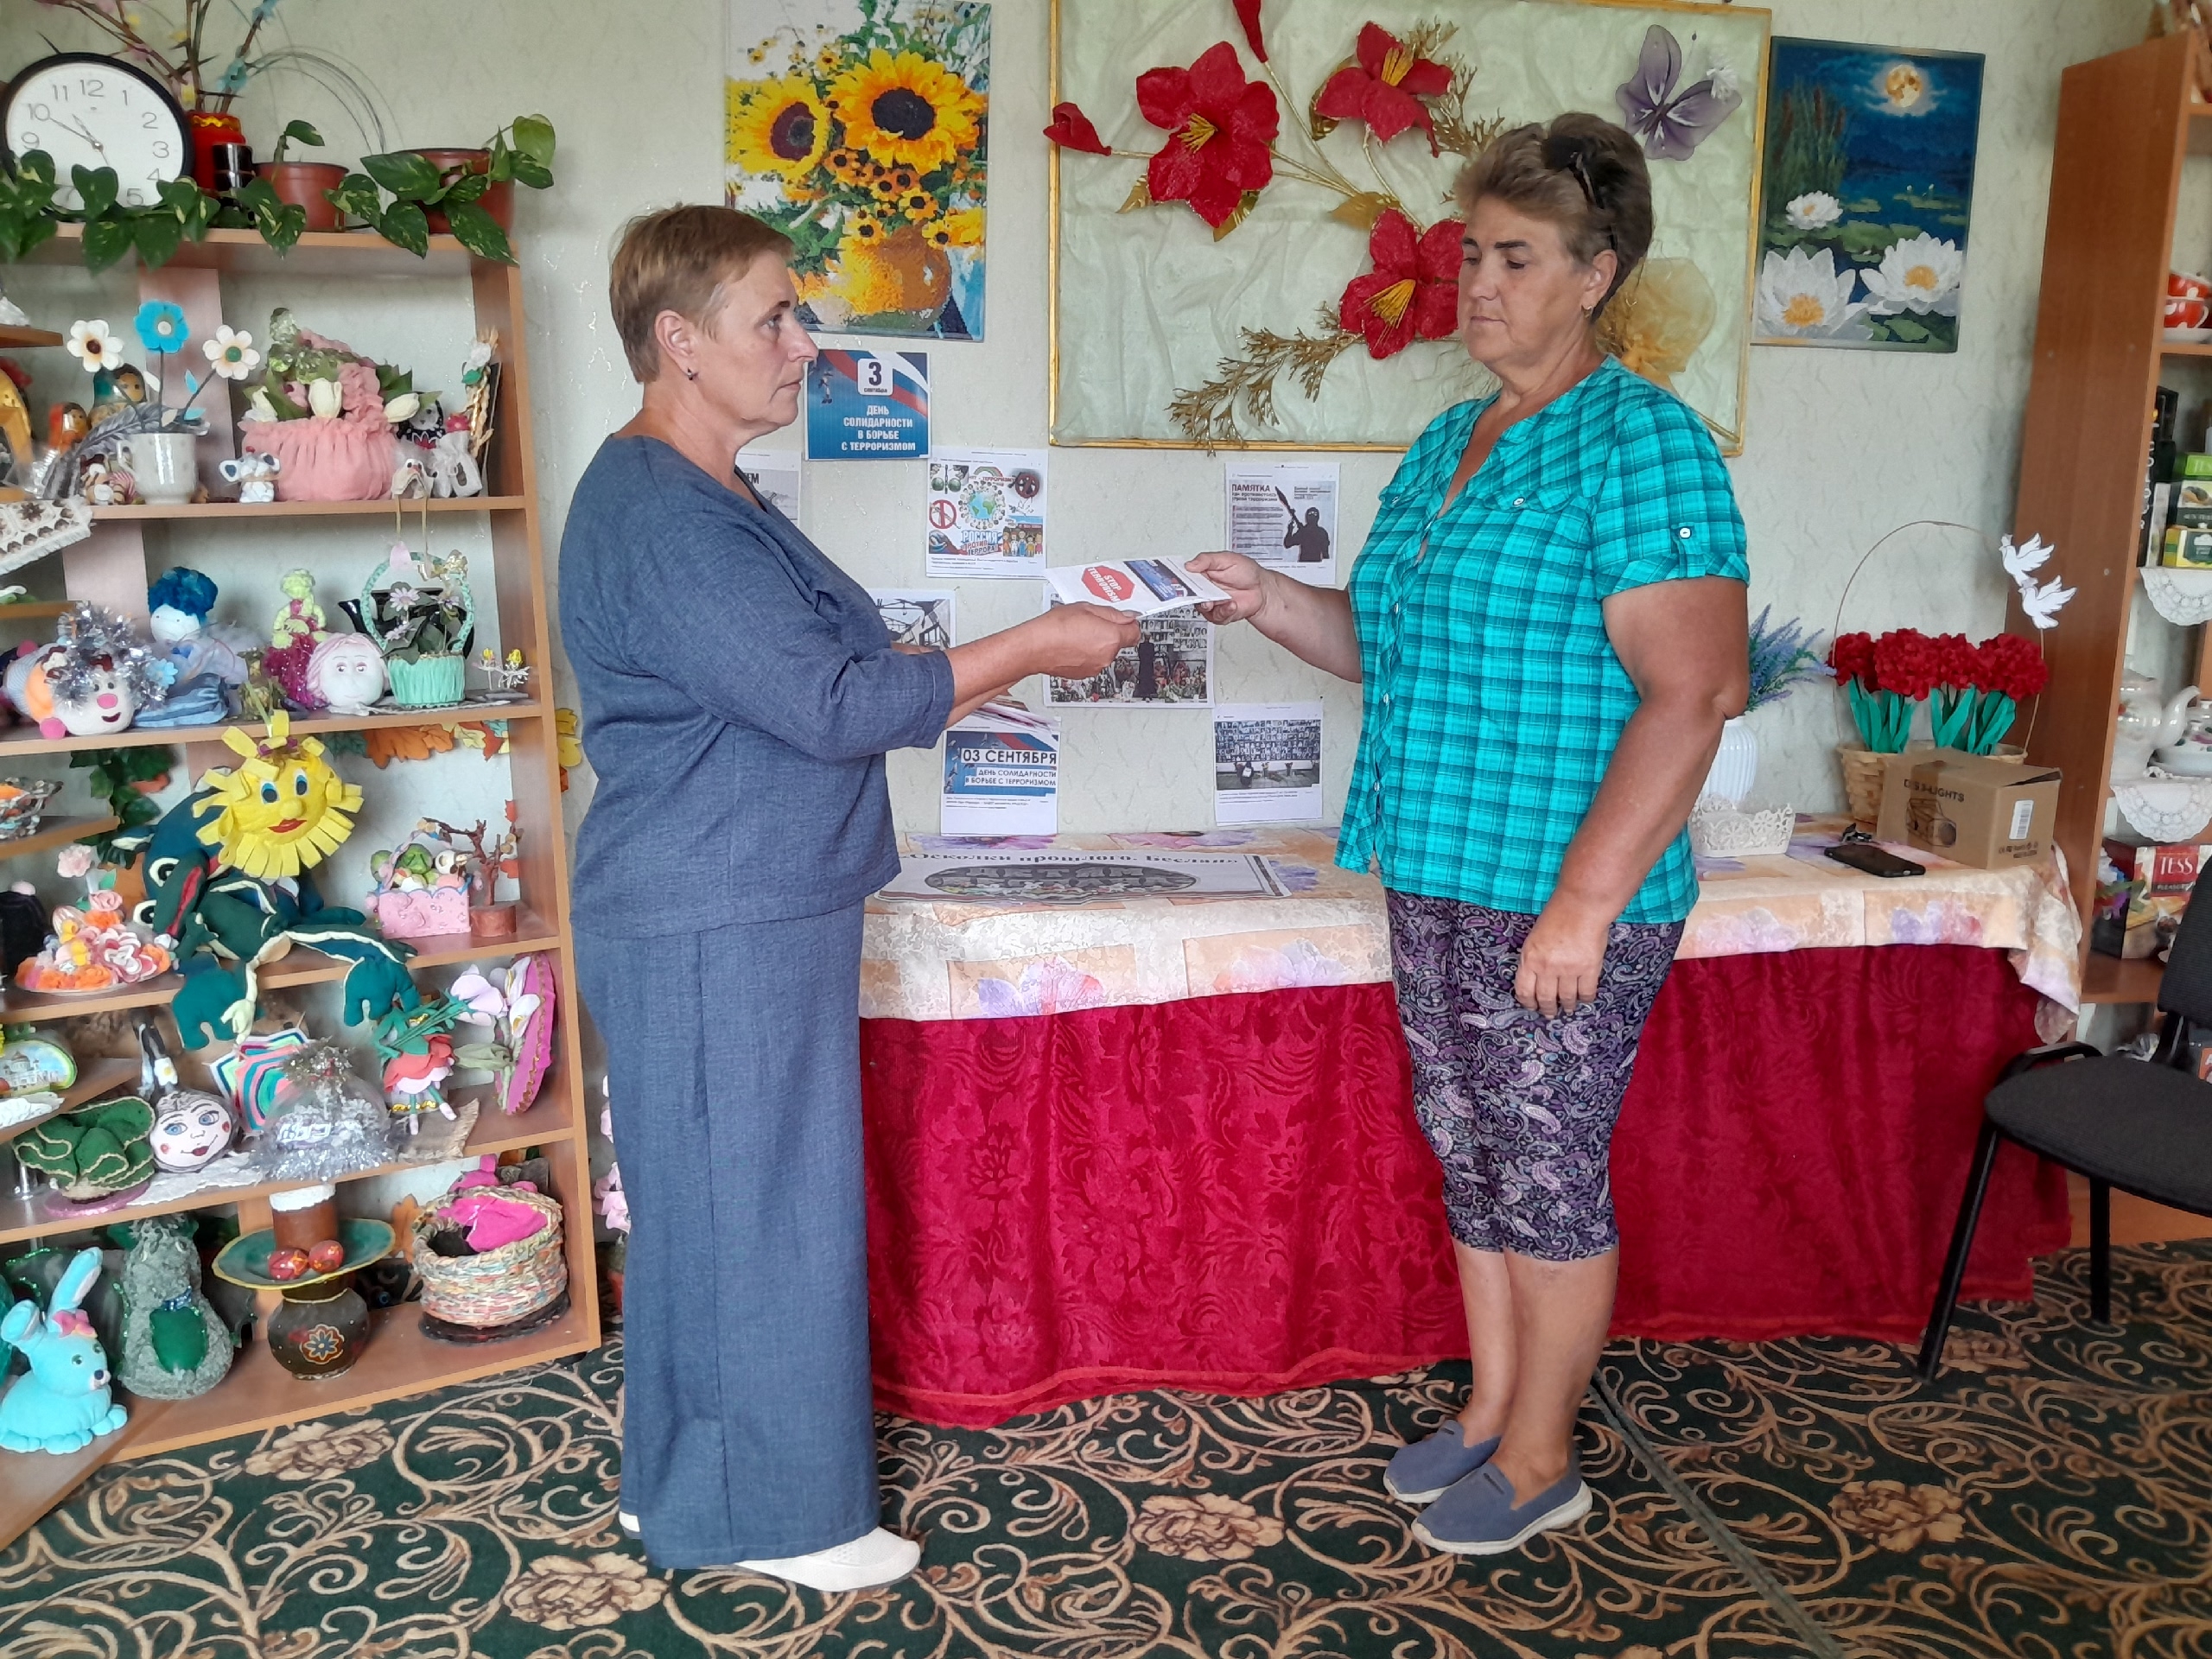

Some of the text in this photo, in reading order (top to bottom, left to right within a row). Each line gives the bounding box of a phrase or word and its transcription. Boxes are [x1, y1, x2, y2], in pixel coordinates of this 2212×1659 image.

[53, 85, 68, 101] 11
[79, 79, 104, 97] 12
[122, 89, 129, 105] 1
[29, 103, 50, 121] 10
[142, 111, 158, 129] 2
[21, 131, 40, 149] 9
[153, 141, 169, 158] 3
[146, 168, 162, 181] 4
[126, 188, 144, 206] 5
[868, 361, 882, 385] 3
[866, 405, 889, 416] ДЕНЬ
[843, 416, 913, 428] СОЛИДАРНОСТИ
[857, 430, 899, 440] В БОРЬБЕ
[842, 442, 916, 451] С ТЕРРОРИЗМОМ
[1231, 484, 1270, 493] ПАМЯТКА
[962, 530, 999, 544] РОССИЯ
[963, 540, 988, 550] ПРОТИВ
[968, 543, 999, 556] ТЕРРОРА!
[1087, 567, 1122, 602] TERRORISM
[1103, 575, 1122, 591] STOP
[963, 749, 1057, 765] 03 СЕНТЯБРЯ
[2160, 856, 2194, 875] TESS
